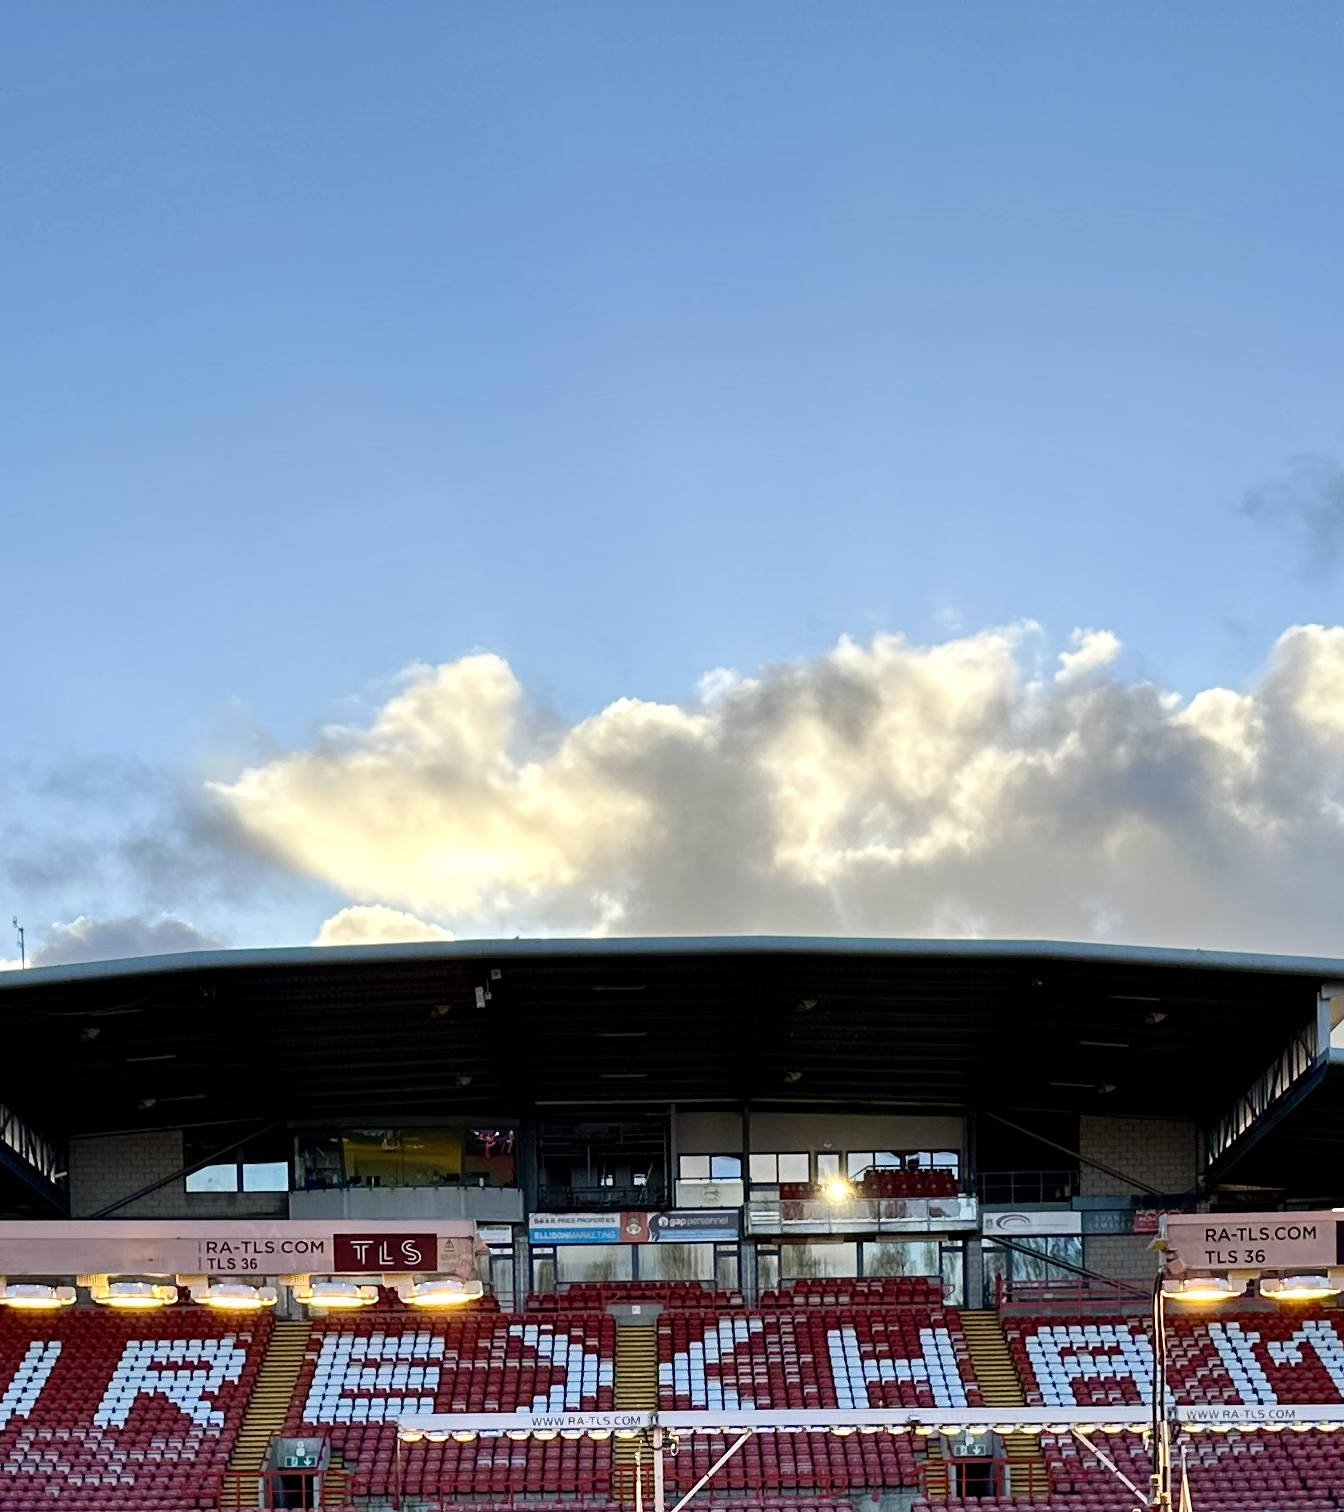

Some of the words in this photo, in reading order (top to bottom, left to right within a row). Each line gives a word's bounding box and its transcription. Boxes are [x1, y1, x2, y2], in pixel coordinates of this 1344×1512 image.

[1205, 1226, 1317, 1243] RA-TLS.COM
[206, 1240, 324, 1254] RA-TLS.COM
[350, 1239, 422, 1266] TLS
[207, 1258, 236, 1270] TLS
[241, 1257, 258, 1270] 36
[1205, 1250, 1238, 1264] TLS
[1244, 1250, 1266, 1263] 36
